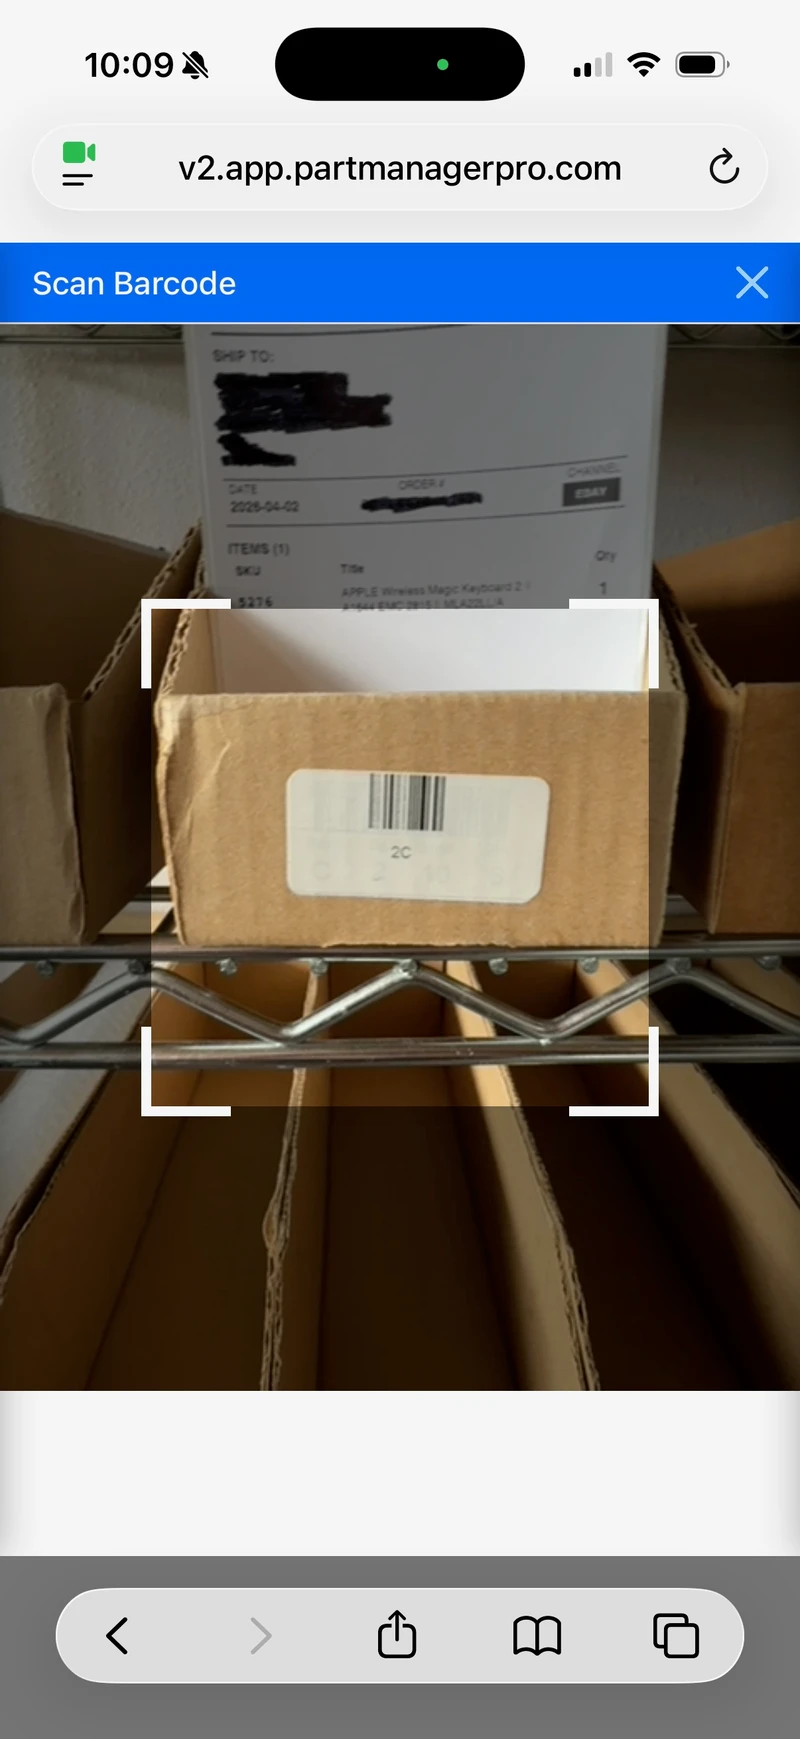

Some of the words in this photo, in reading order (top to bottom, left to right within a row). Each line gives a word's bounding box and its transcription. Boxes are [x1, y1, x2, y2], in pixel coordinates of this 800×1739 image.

[84, 52, 174, 78] 10:09
[178, 154, 622, 186] v2.app.partmanagerpro.com
[32, 271, 104, 297] Scan
[113, 271, 236, 297] Barcode
[212, 349, 246, 363] SHIP
[250, 349, 275, 363] TO:
[398, 479, 438, 490] ORDER
[574, 486, 608, 499] EBAY
[227, 543, 269, 555] ITEMS
[272, 543, 290, 557] (1)
[594, 550, 617, 563] Qty
[235, 565, 261, 576] SKU
[340, 563, 365, 574] Title
[341, 587, 379, 598] APPLE
[381, 586, 425, 597] Wireless
[427, 584, 460, 597] Magic
[461, 582, 513, 596] Keyboard
[598, 581, 608, 595] 1
[390, 845, 413, 859] 2C
